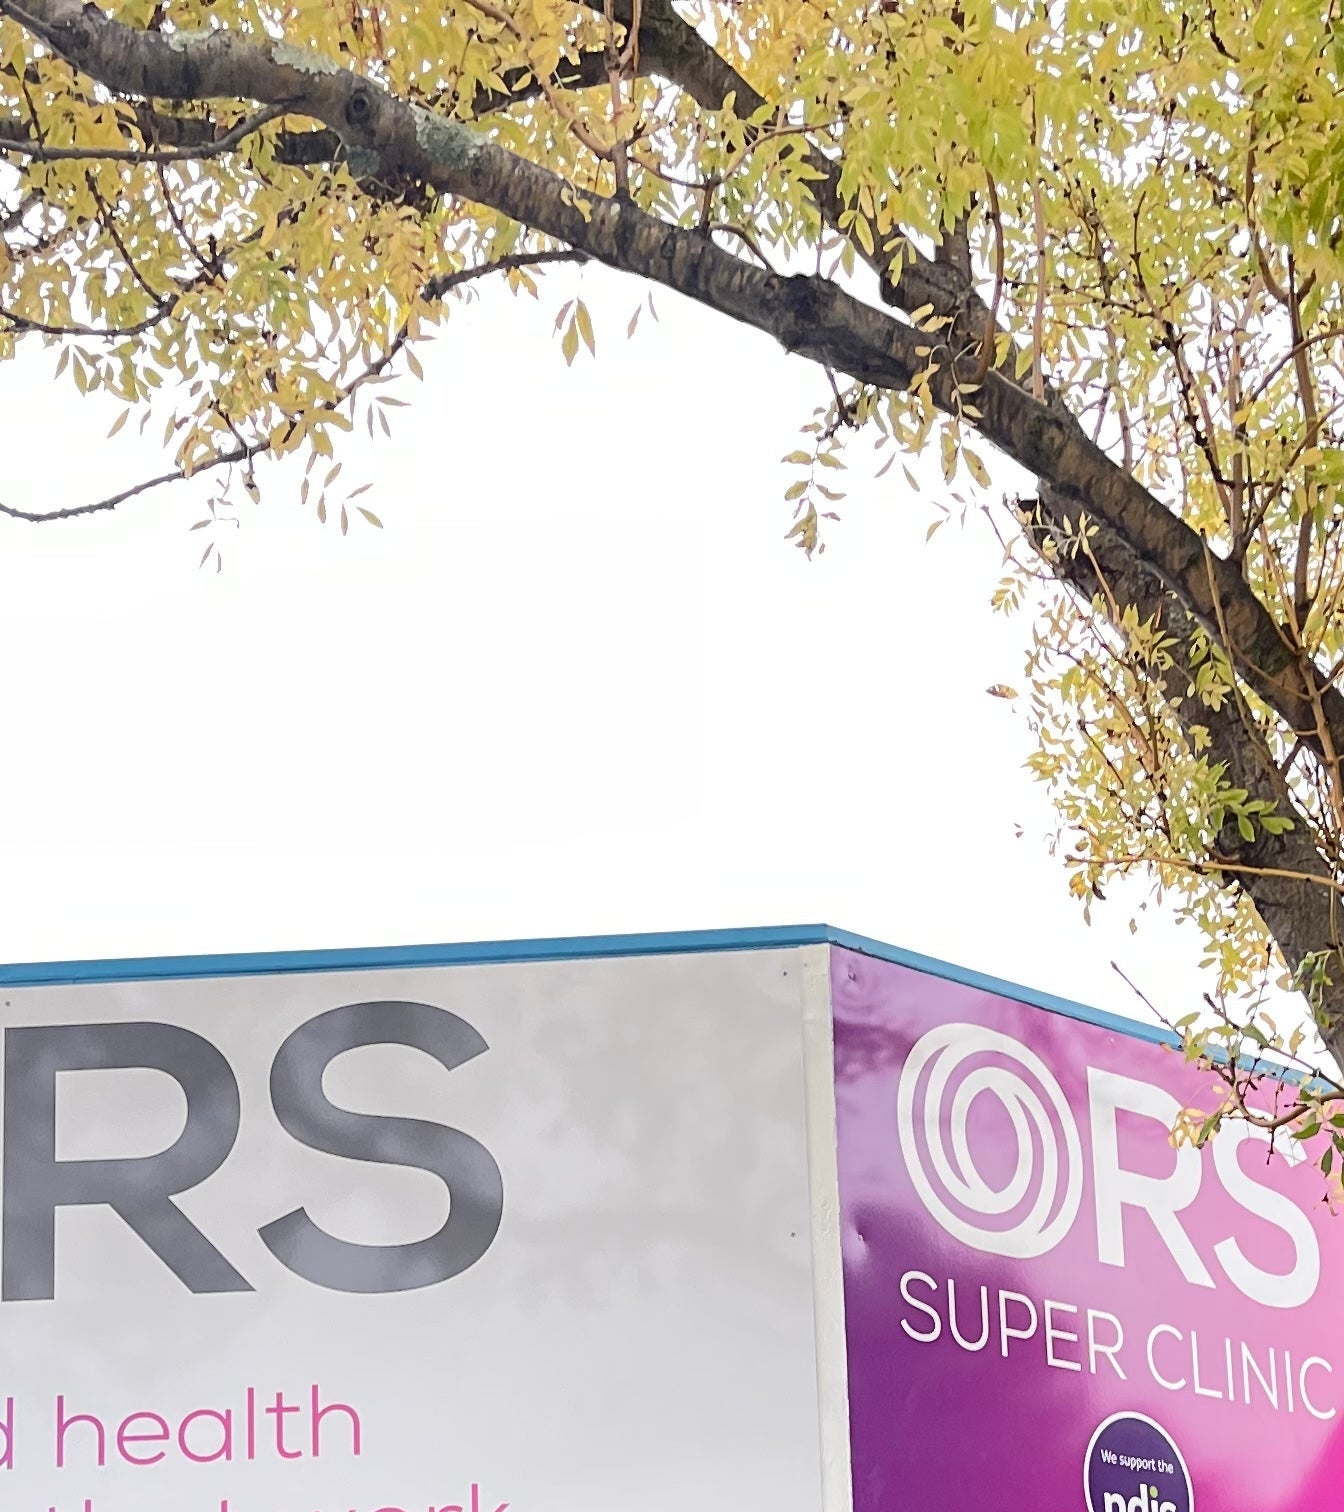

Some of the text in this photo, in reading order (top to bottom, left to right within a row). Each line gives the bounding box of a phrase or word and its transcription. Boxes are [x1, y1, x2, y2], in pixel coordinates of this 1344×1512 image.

[897, 1022, 1321, 1310] ORS
[899, 1270, 1338, 1420] SUPER CLINIC
[56, 1384, 362, 1468] health
[1100, 1449, 1174, 1475] We support the
